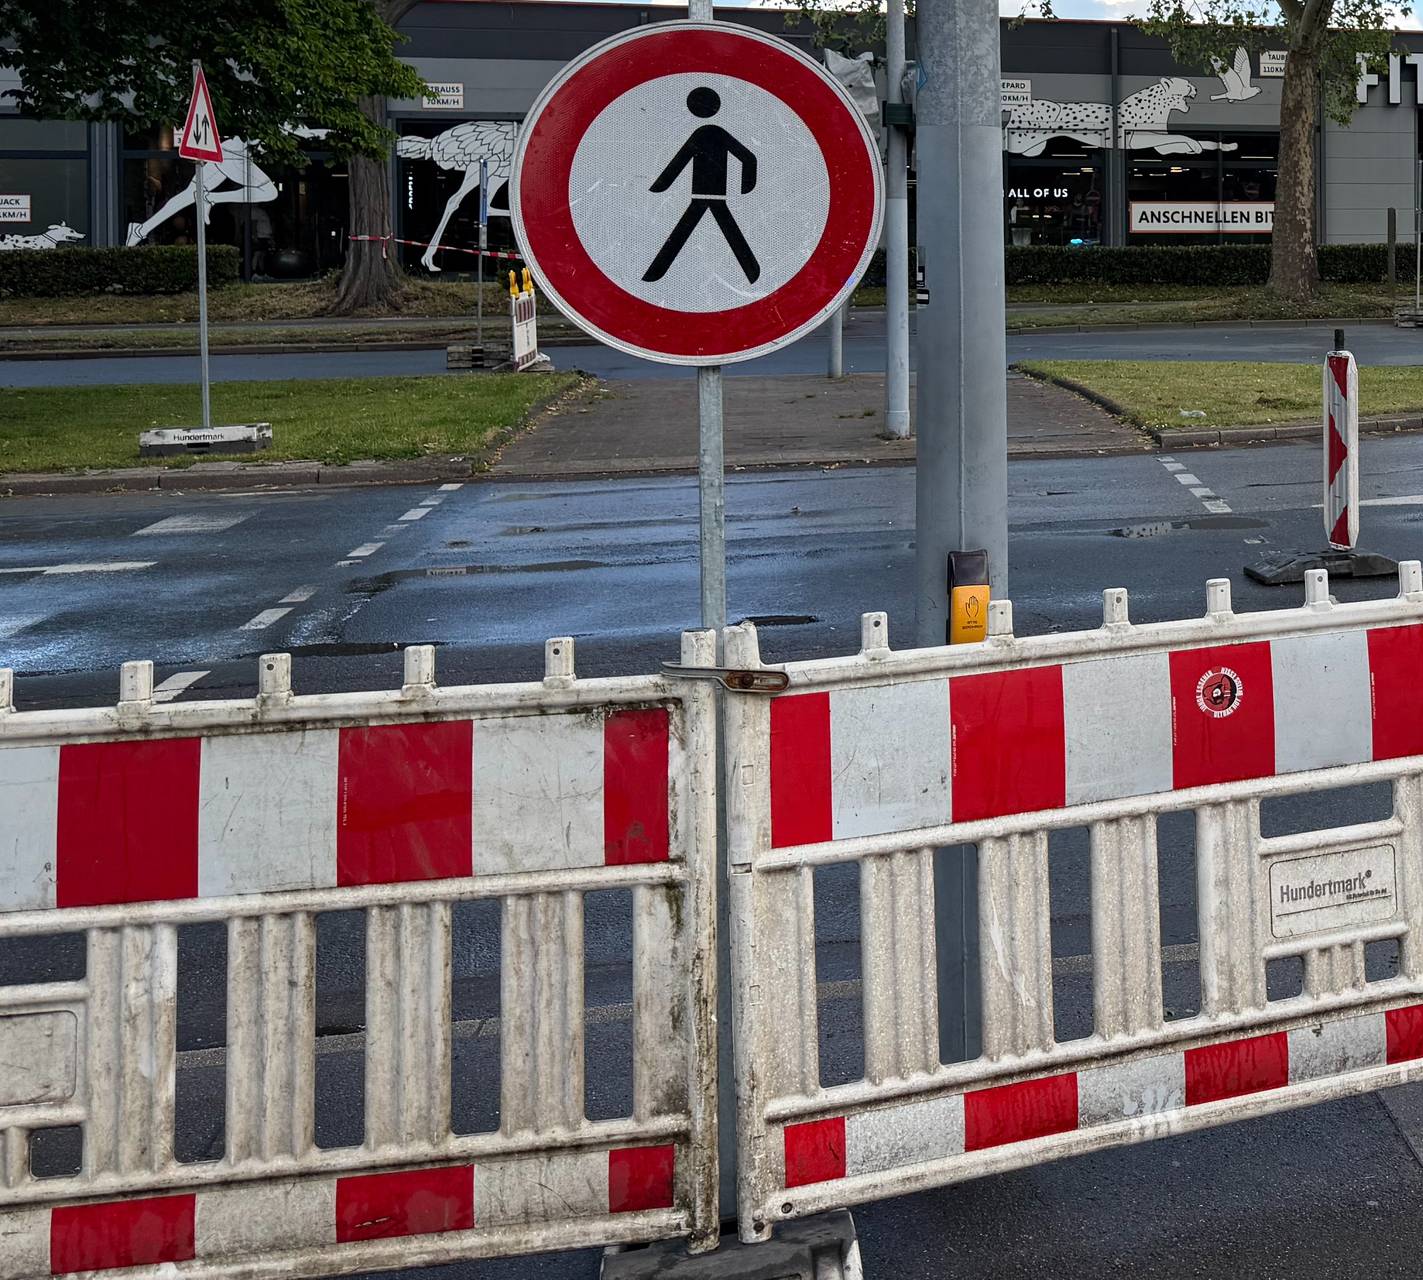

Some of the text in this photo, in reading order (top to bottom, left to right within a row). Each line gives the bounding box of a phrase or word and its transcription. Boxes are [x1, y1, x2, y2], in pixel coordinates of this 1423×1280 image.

[1008, 188, 1069, 198] ALL OF US
[0, 211, 27, 219] KM/H
[1138, 210, 1250, 224] ANSCHNELLEN
[173, 432, 225, 442] Hundertmark
